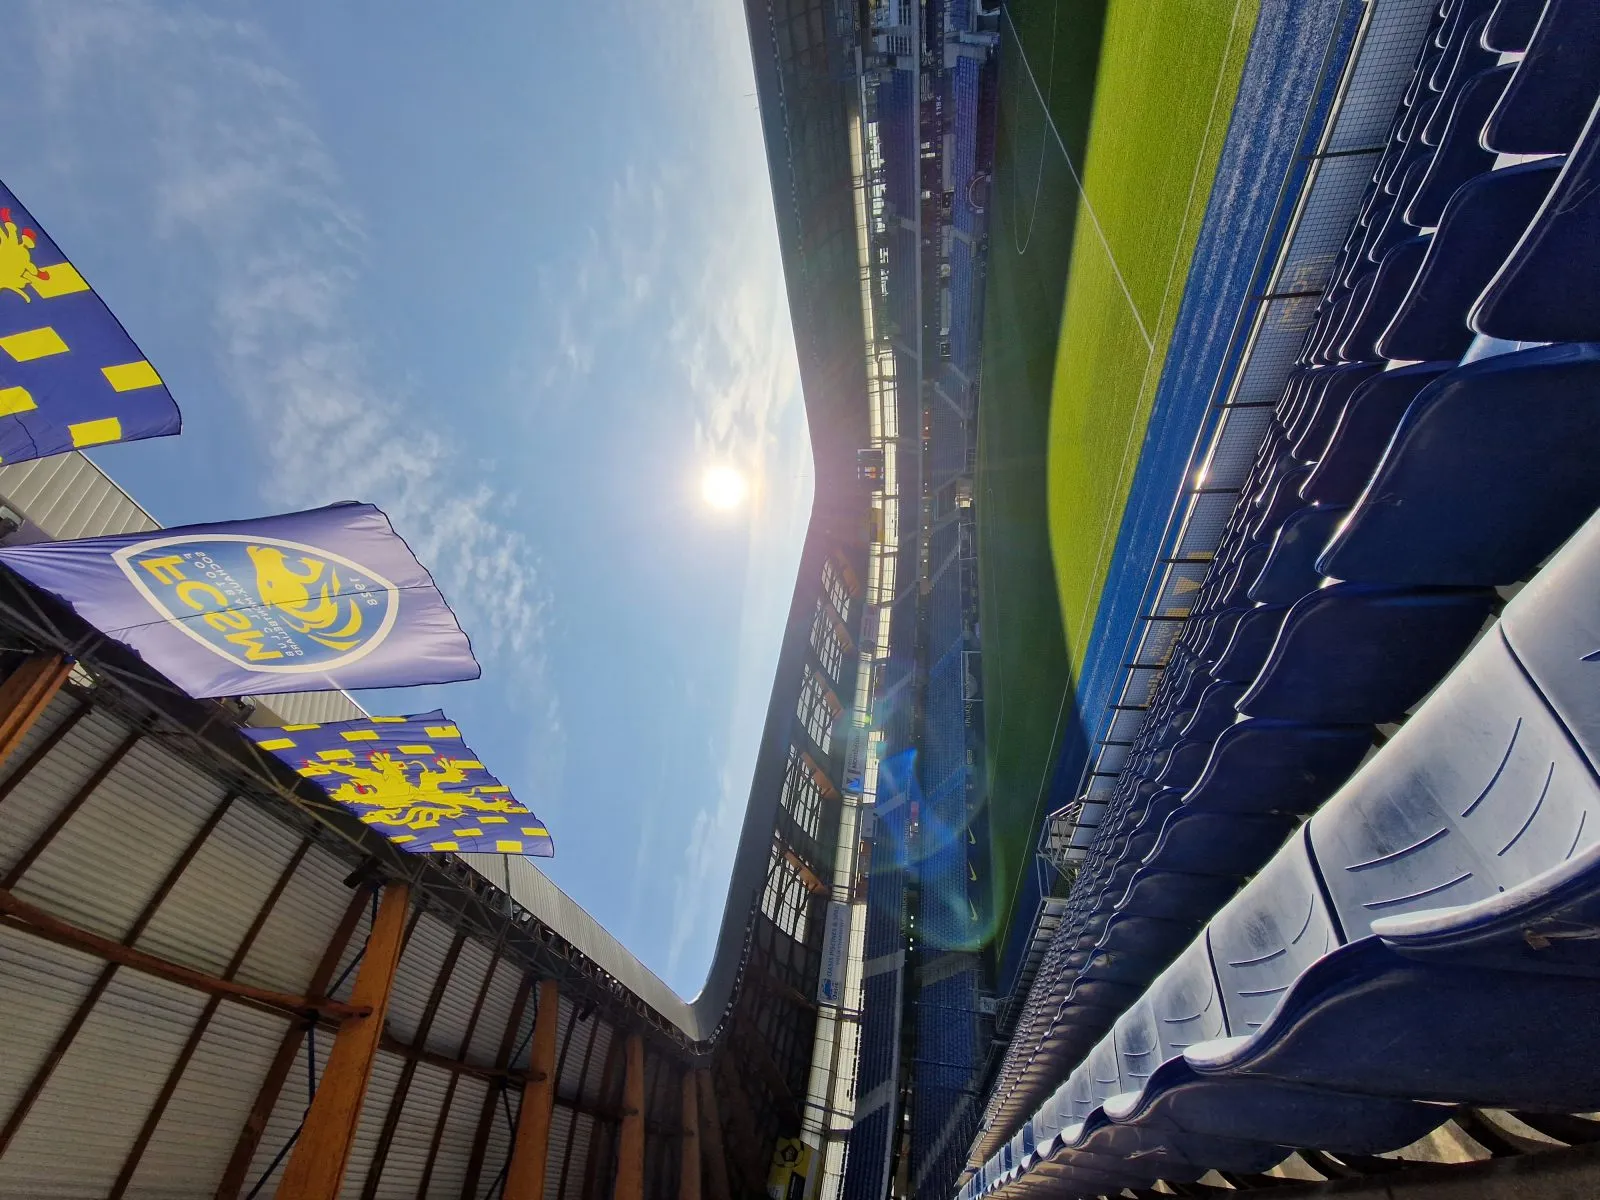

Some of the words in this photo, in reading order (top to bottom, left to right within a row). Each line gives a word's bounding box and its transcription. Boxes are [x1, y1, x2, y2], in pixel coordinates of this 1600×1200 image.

[832, 906, 840, 920] SPAS
[828, 928, 837, 956] PISCINES
[826, 957, 834, 977] OASIS
